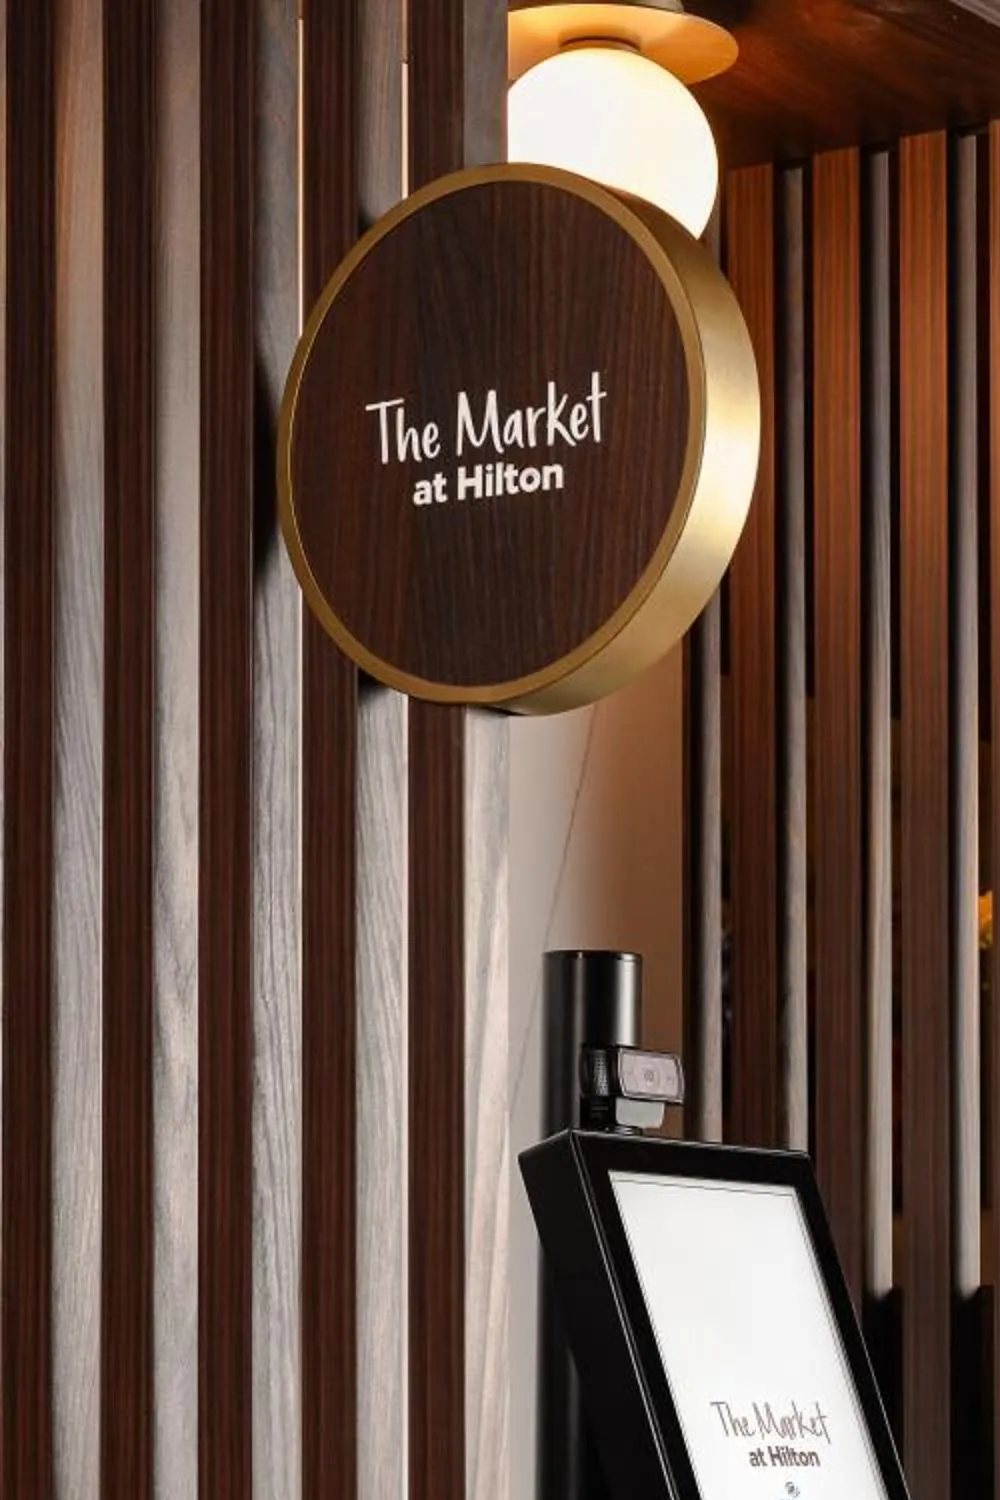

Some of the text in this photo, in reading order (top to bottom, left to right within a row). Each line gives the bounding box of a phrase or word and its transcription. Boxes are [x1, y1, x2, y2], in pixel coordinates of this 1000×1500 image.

[365, 371, 607, 464] The Market
[413, 462, 565, 506] at Hilton
[710, 1400, 831, 1445] The Market
[749, 1446, 821, 1468] at Hilton
